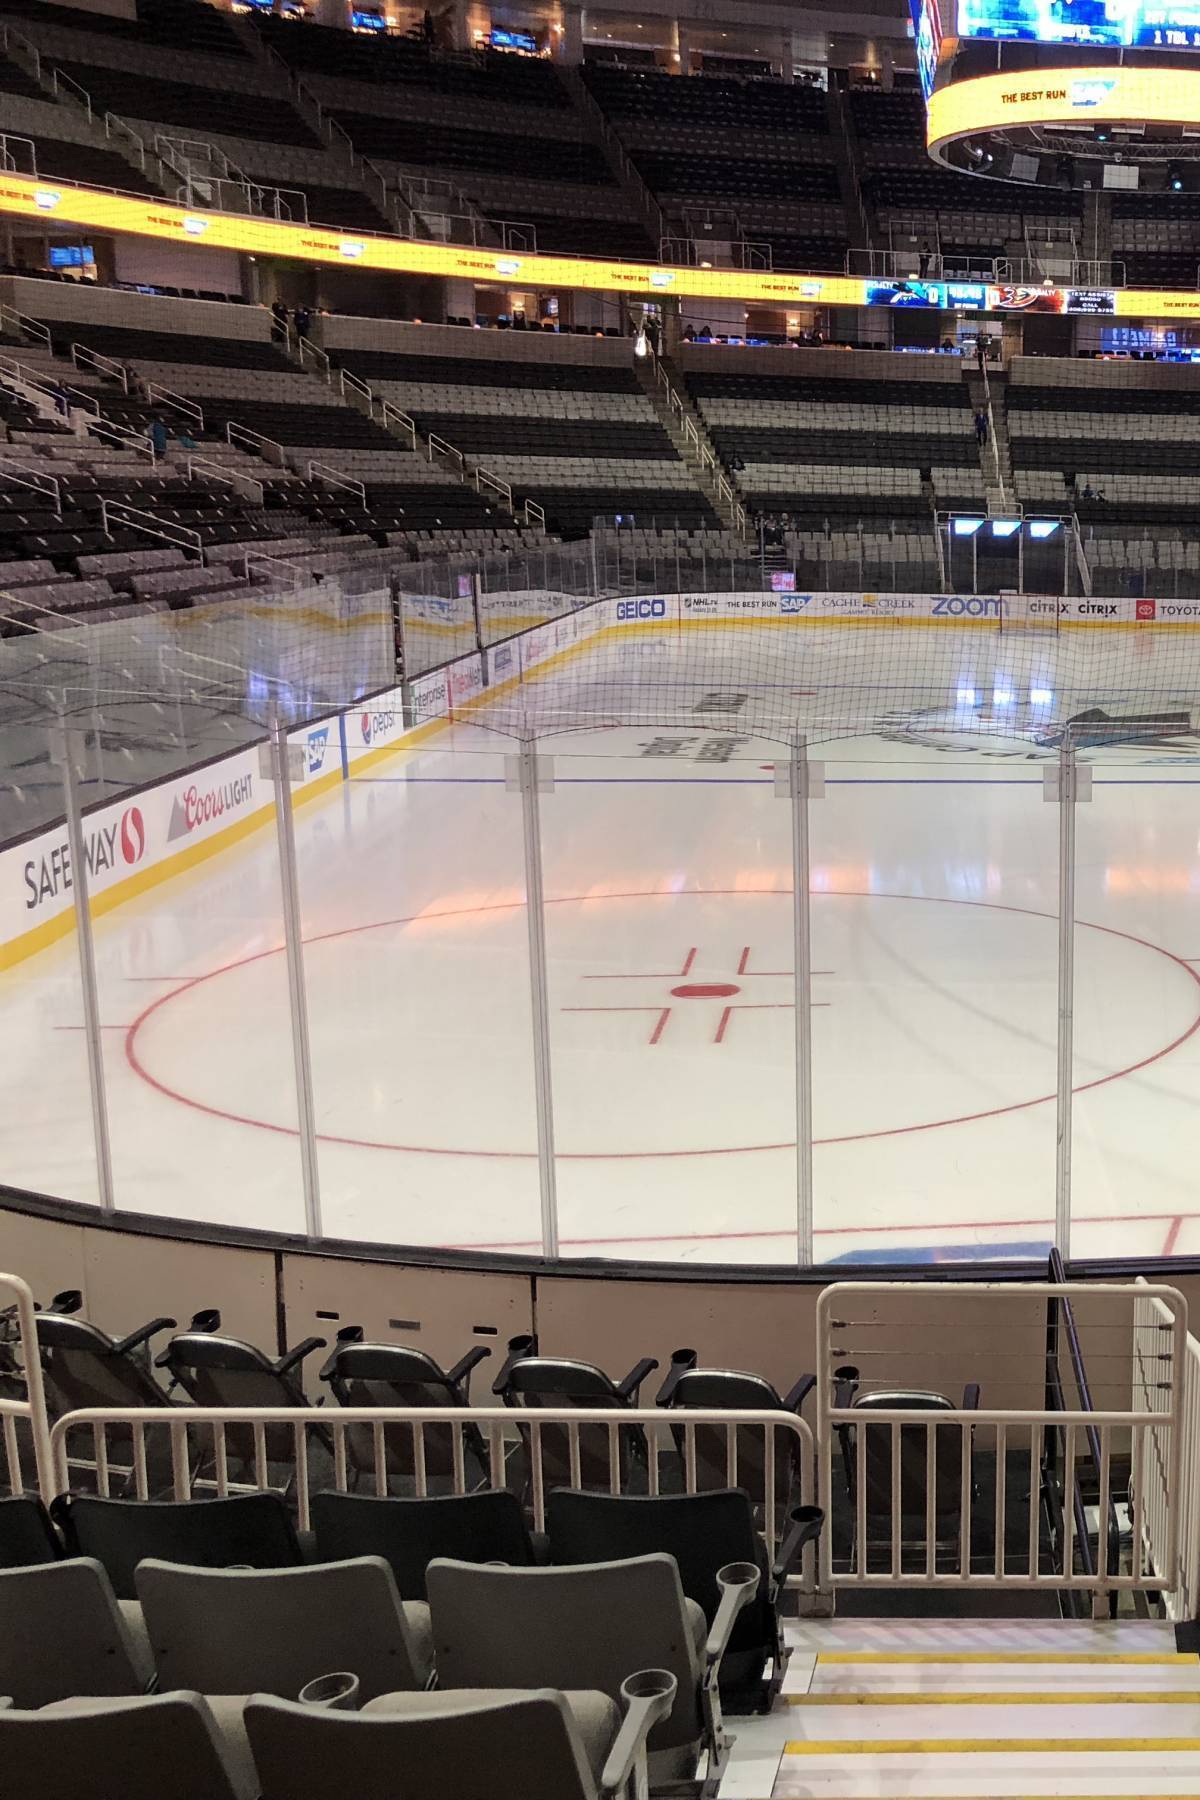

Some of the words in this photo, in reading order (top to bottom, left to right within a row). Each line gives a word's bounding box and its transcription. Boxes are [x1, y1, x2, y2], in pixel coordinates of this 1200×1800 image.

[1002, 93, 1018, 104] THE
[1020, 91, 1043, 102] BEST
[1046, 90, 1066, 100] RUN
[616, 600, 666, 620] GEICO
[782, 598, 806, 611] SAP
[822, 598, 860, 608] CACHE
[878, 599, 916, 608] CREEK
[412, 684, 446, 712] nterprise
[372, 710, 395, 740] pepsi
[183, 784, 224, 831] Coors
[224, 774, 253, 811] LIGHT
